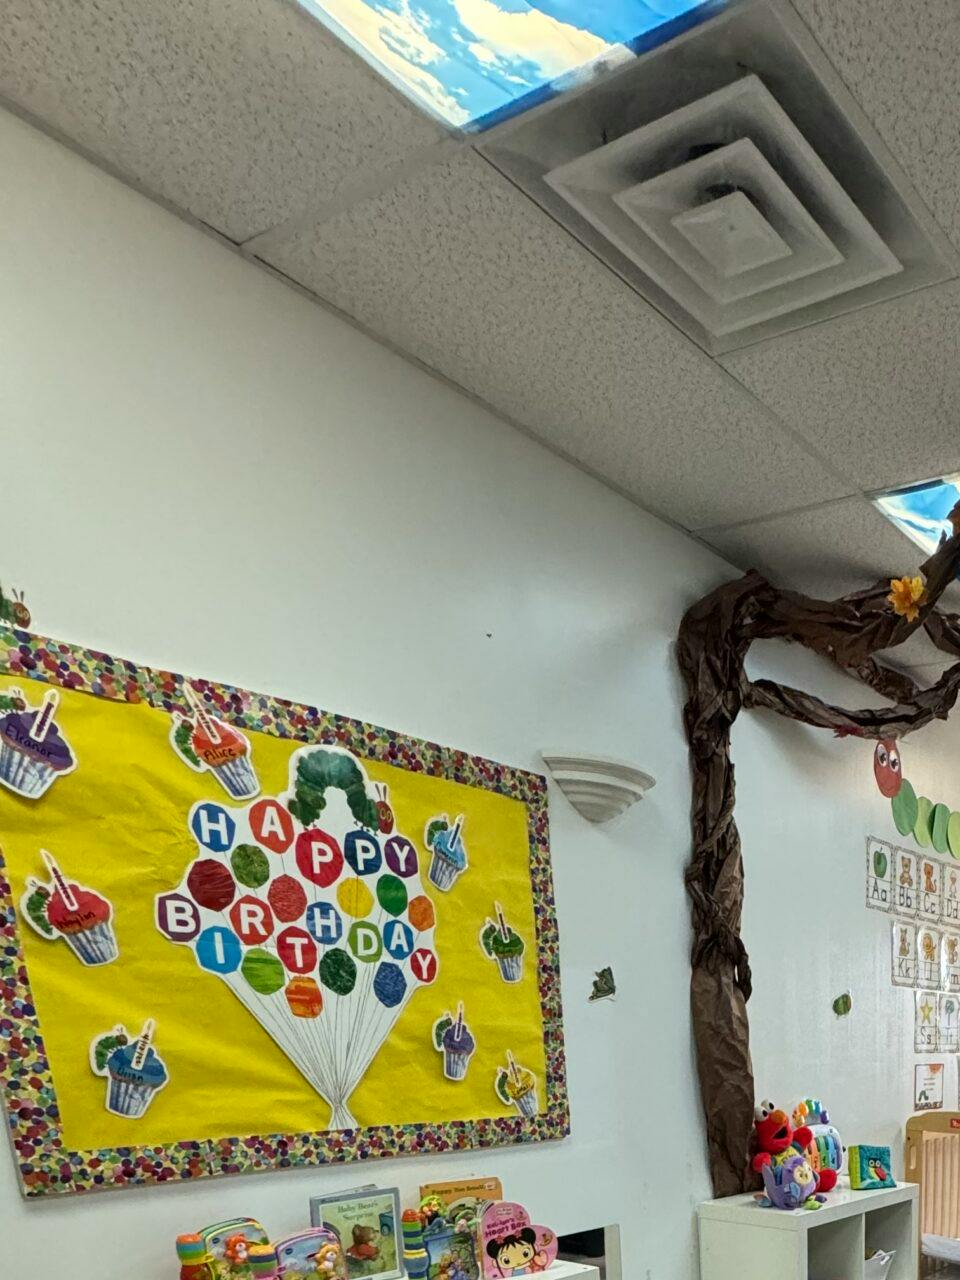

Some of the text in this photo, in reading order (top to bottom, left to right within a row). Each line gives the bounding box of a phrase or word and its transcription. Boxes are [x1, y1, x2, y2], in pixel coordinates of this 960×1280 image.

[203, 747, 236, 761] Alice
[199, 806, 410, 874] HAPPY
[872, 882, 887, 902] Aa
[899, 887, 912, 908] Bb
[923, 892, 936, 914] Cc
[946, 898, 958, 919] Dd
[165, 899, 431, 980] BIRTHDAY
[920, 1026, 931, 1045] Ss
